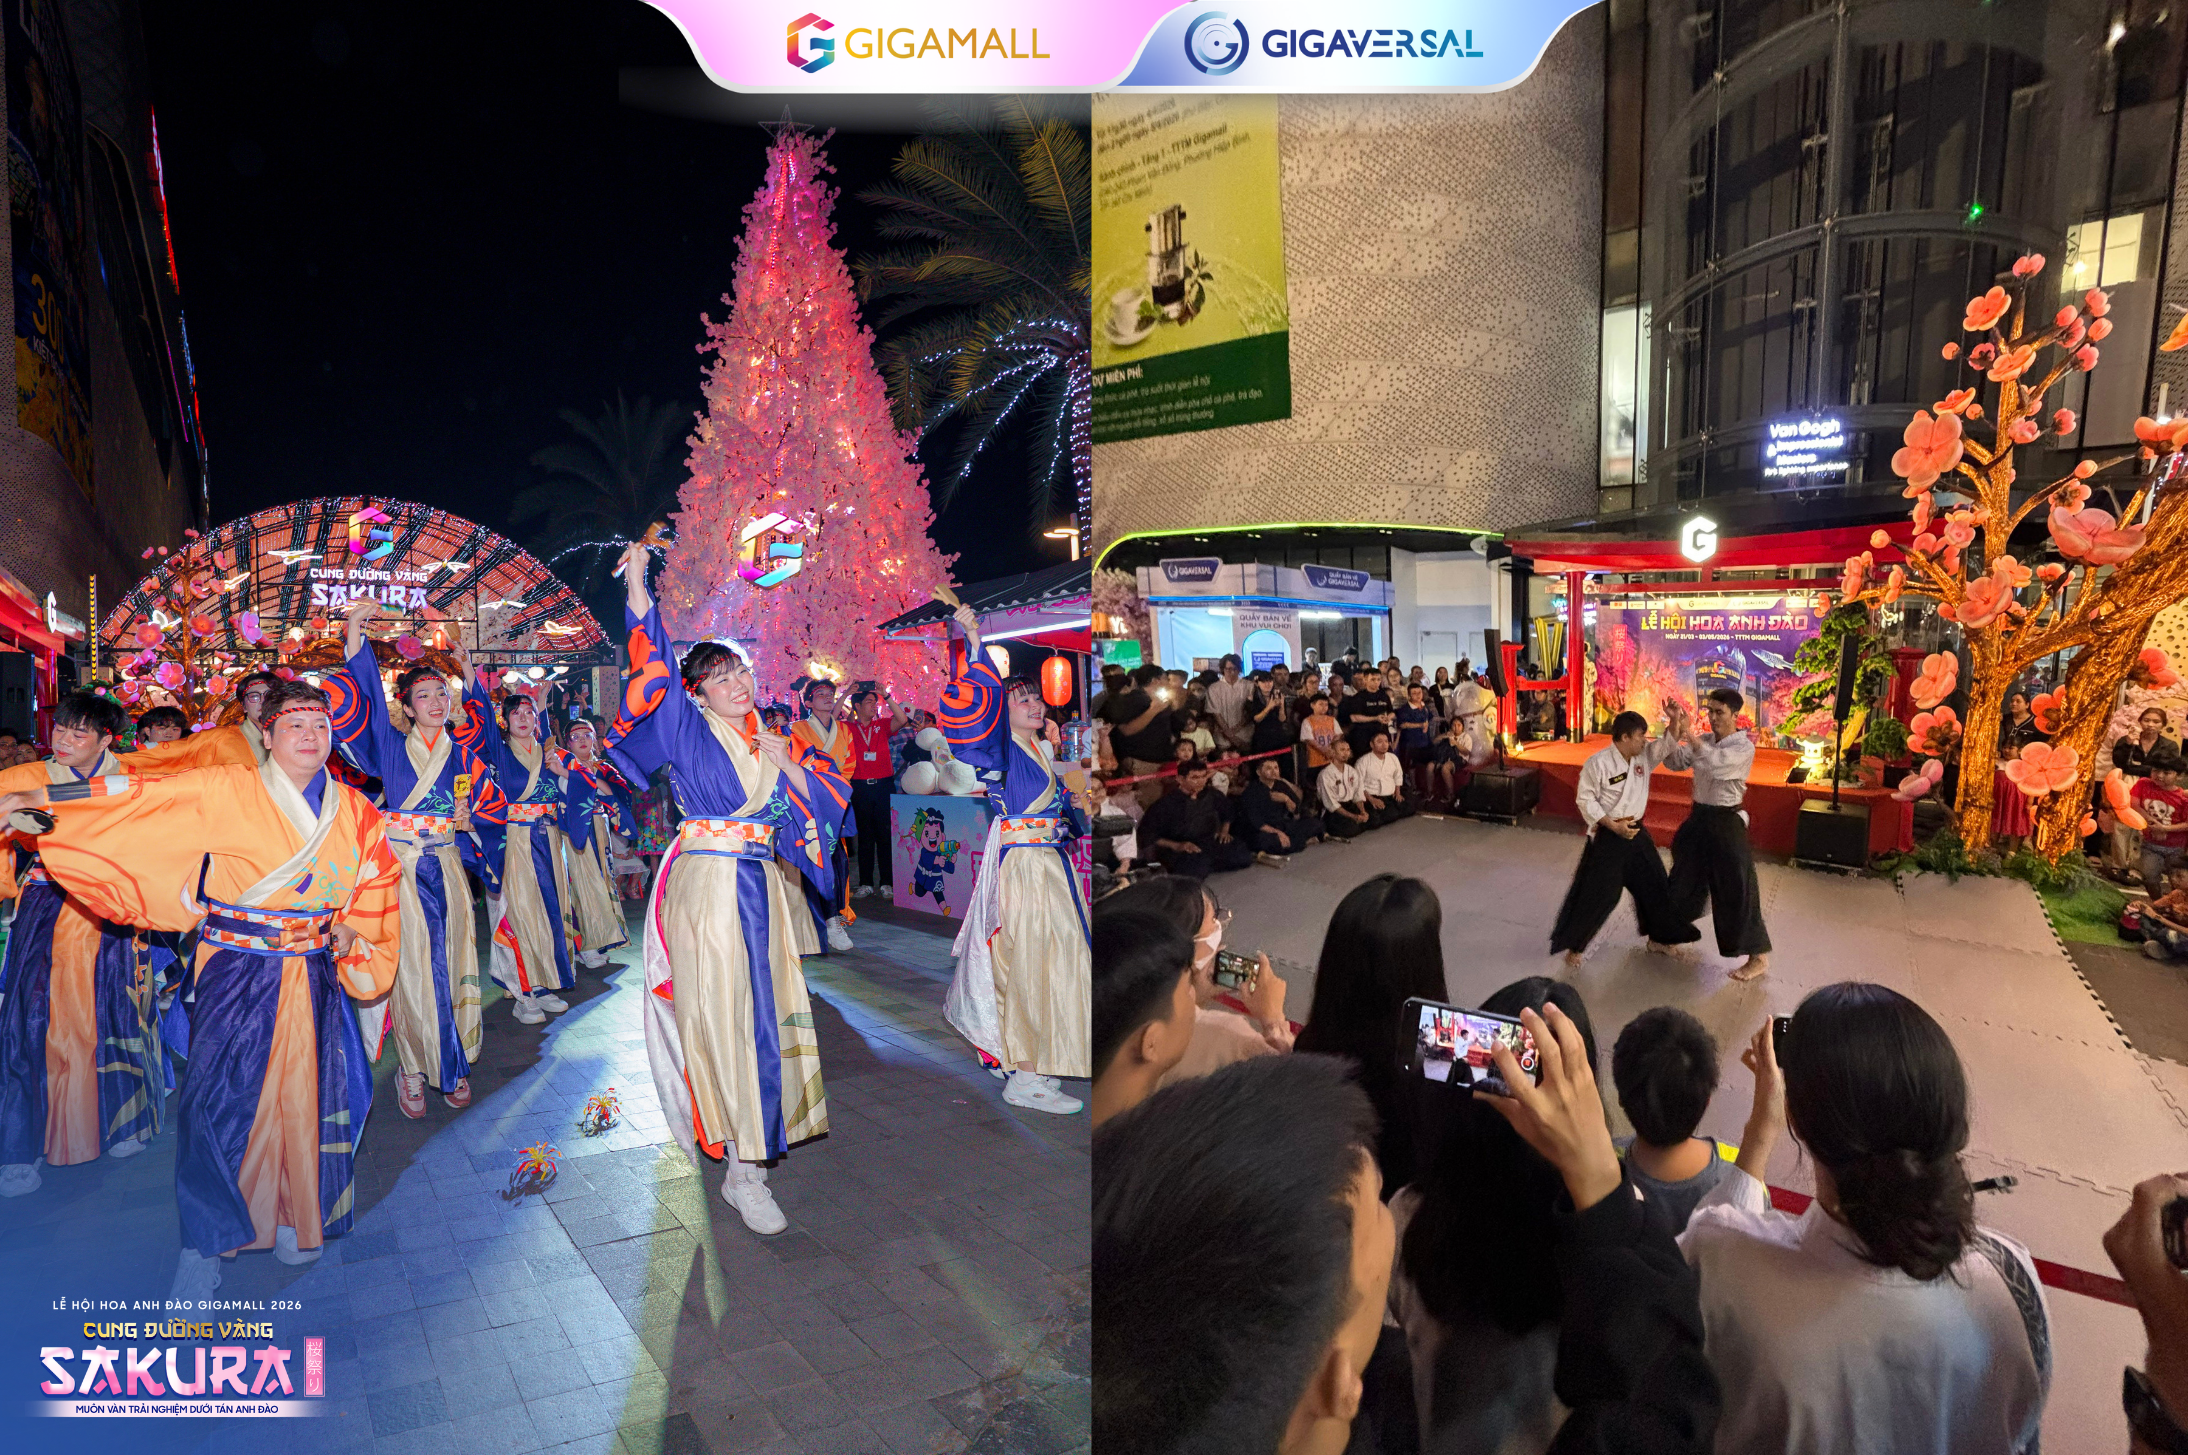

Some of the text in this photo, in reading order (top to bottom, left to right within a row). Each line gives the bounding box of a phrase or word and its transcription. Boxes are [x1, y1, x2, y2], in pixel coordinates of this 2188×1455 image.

[1193, 122, 1228, 144] Gigamall
[1770, 419, 1840, 438] Van Gogh
[310, 566, 428, 582] CUNG ĐƯỜNG VÀNG
[1179, 566, 1212, 576] GIGAVERSAL
[311, 583, 429, 609] SAKURA
[1641, 610, 1808, 633] LỄ HỘI HOA ANH ĐÀO
